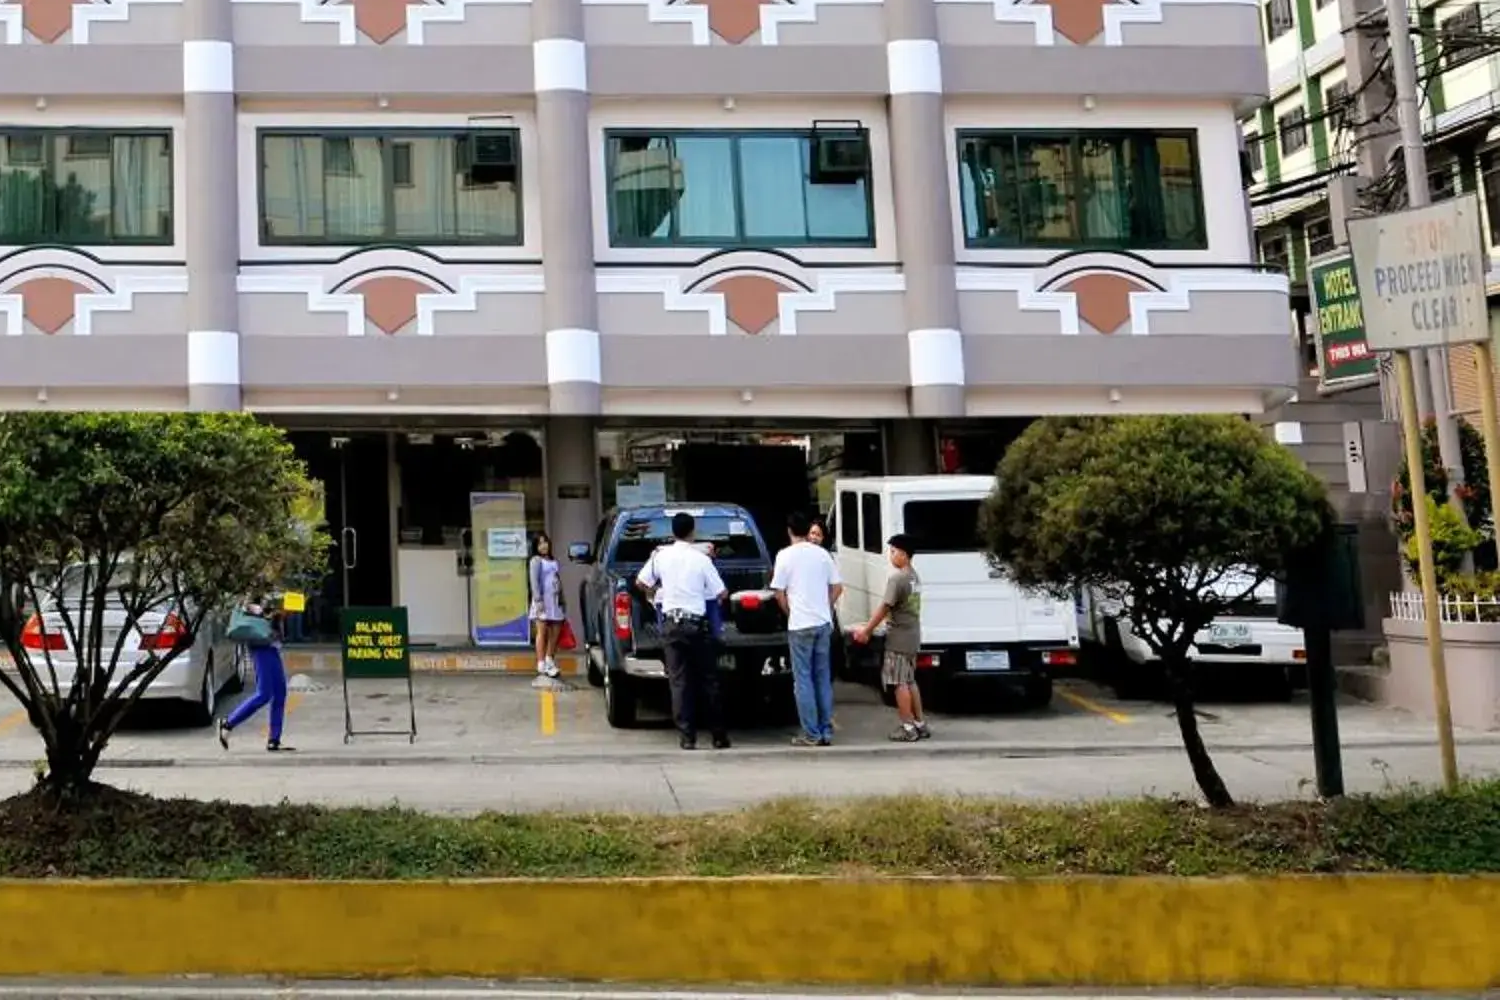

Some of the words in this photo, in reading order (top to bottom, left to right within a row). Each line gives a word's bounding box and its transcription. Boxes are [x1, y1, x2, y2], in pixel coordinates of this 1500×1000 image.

[1323, 266, 1357, 300] HOTEL
[1374, 258, 1441, 296] PROCEED
[1412, 295, 1458, 330] CLEAR
[347, 635, 373, 646] HOTEL
[383, 647, 404, 660] ONLY
